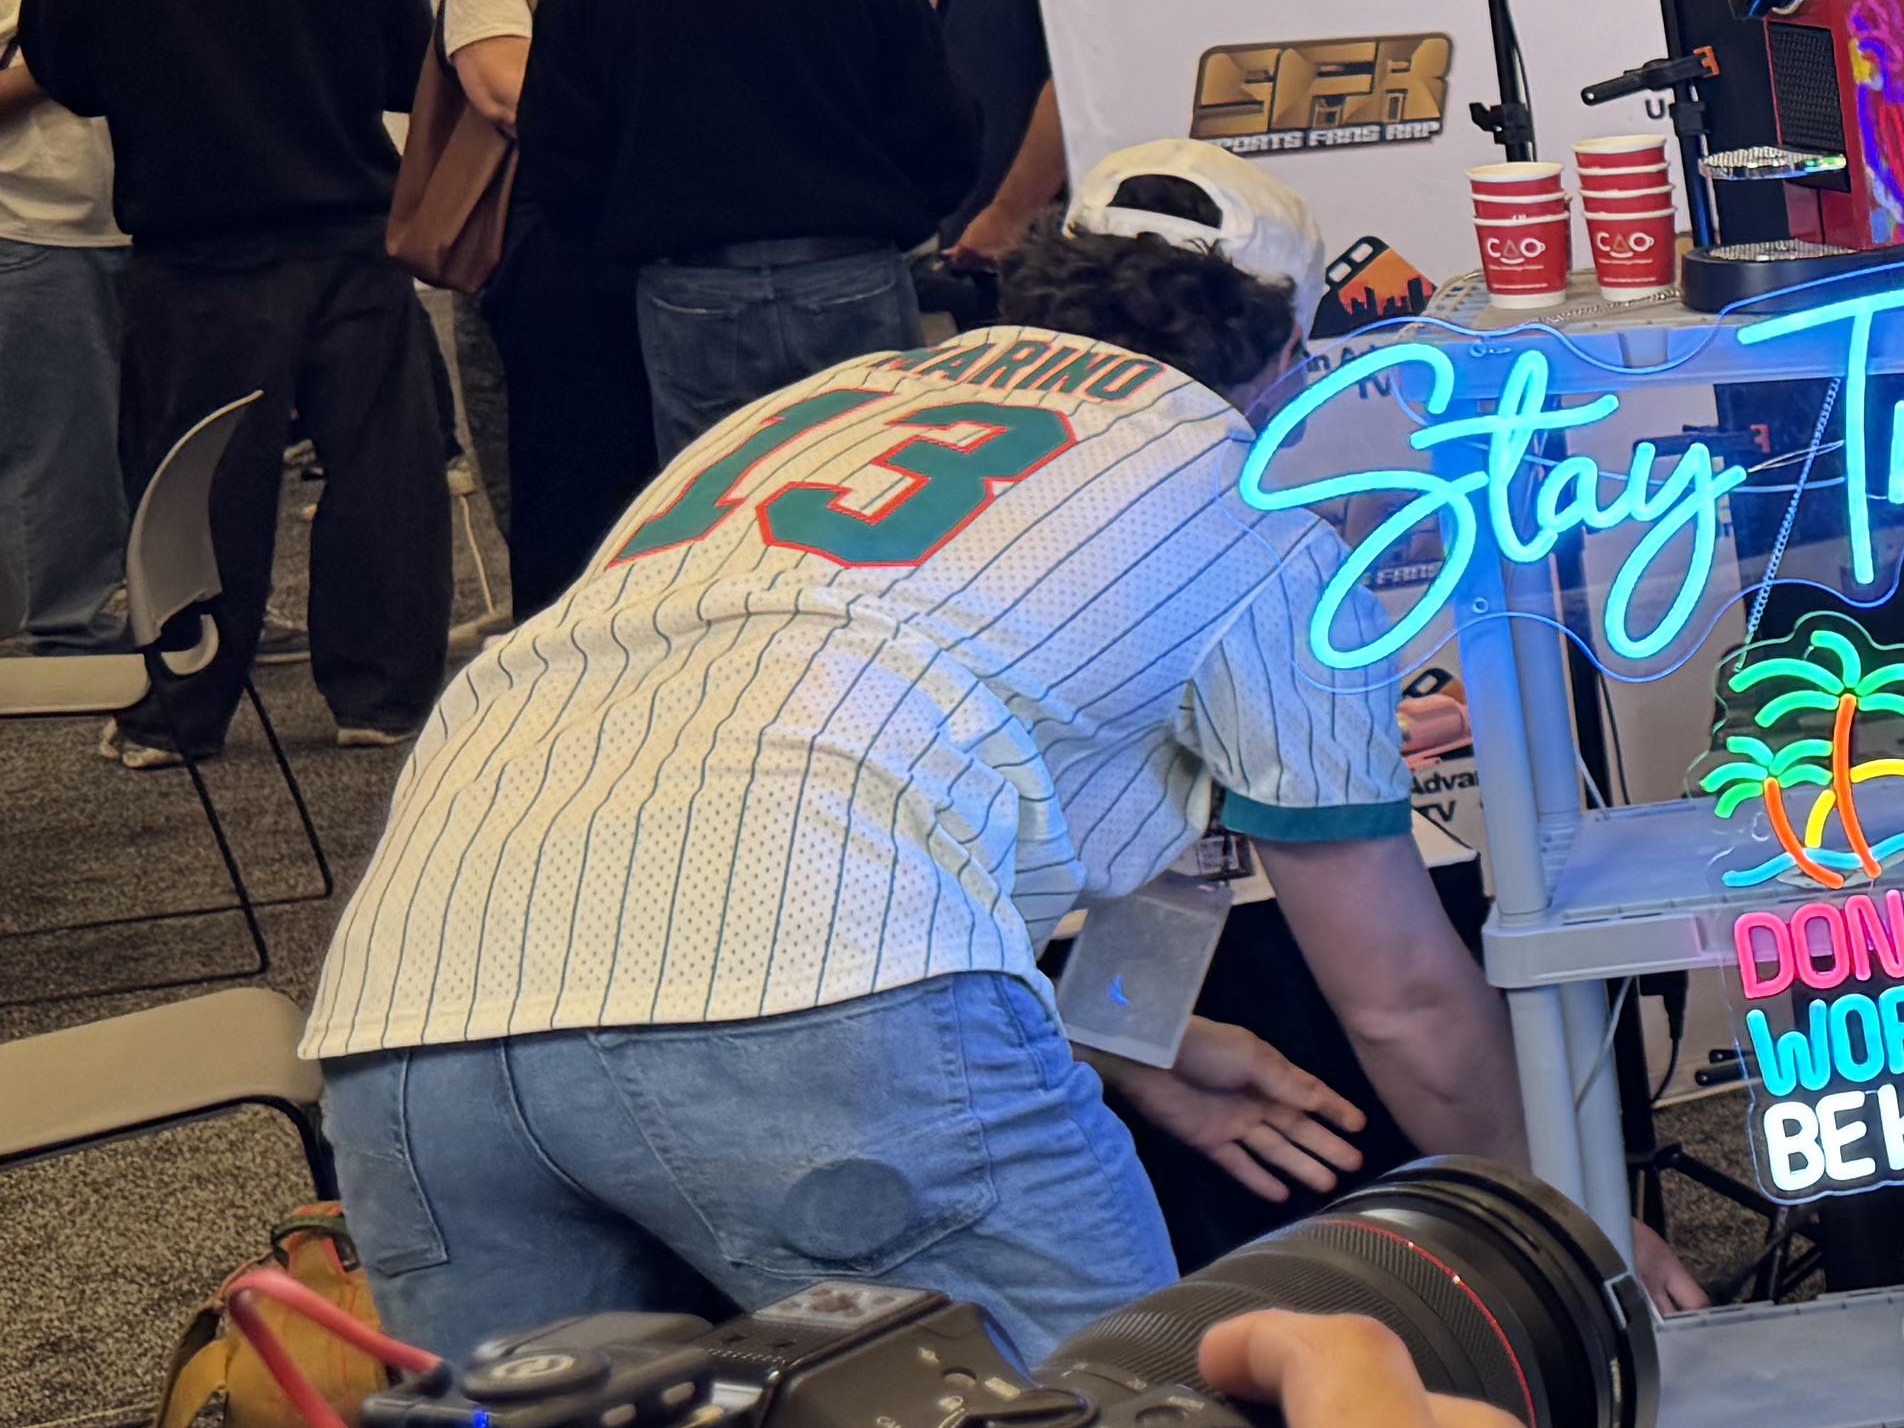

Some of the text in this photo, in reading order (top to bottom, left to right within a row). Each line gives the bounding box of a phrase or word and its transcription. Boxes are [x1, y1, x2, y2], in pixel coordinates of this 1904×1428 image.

[1208, 130, 1305, 154] PORTS
[1309, 125, 1381, 148] FANS
[604, 387, 1080, 569] 13
[1239, 342, 1747, 670] Stay
